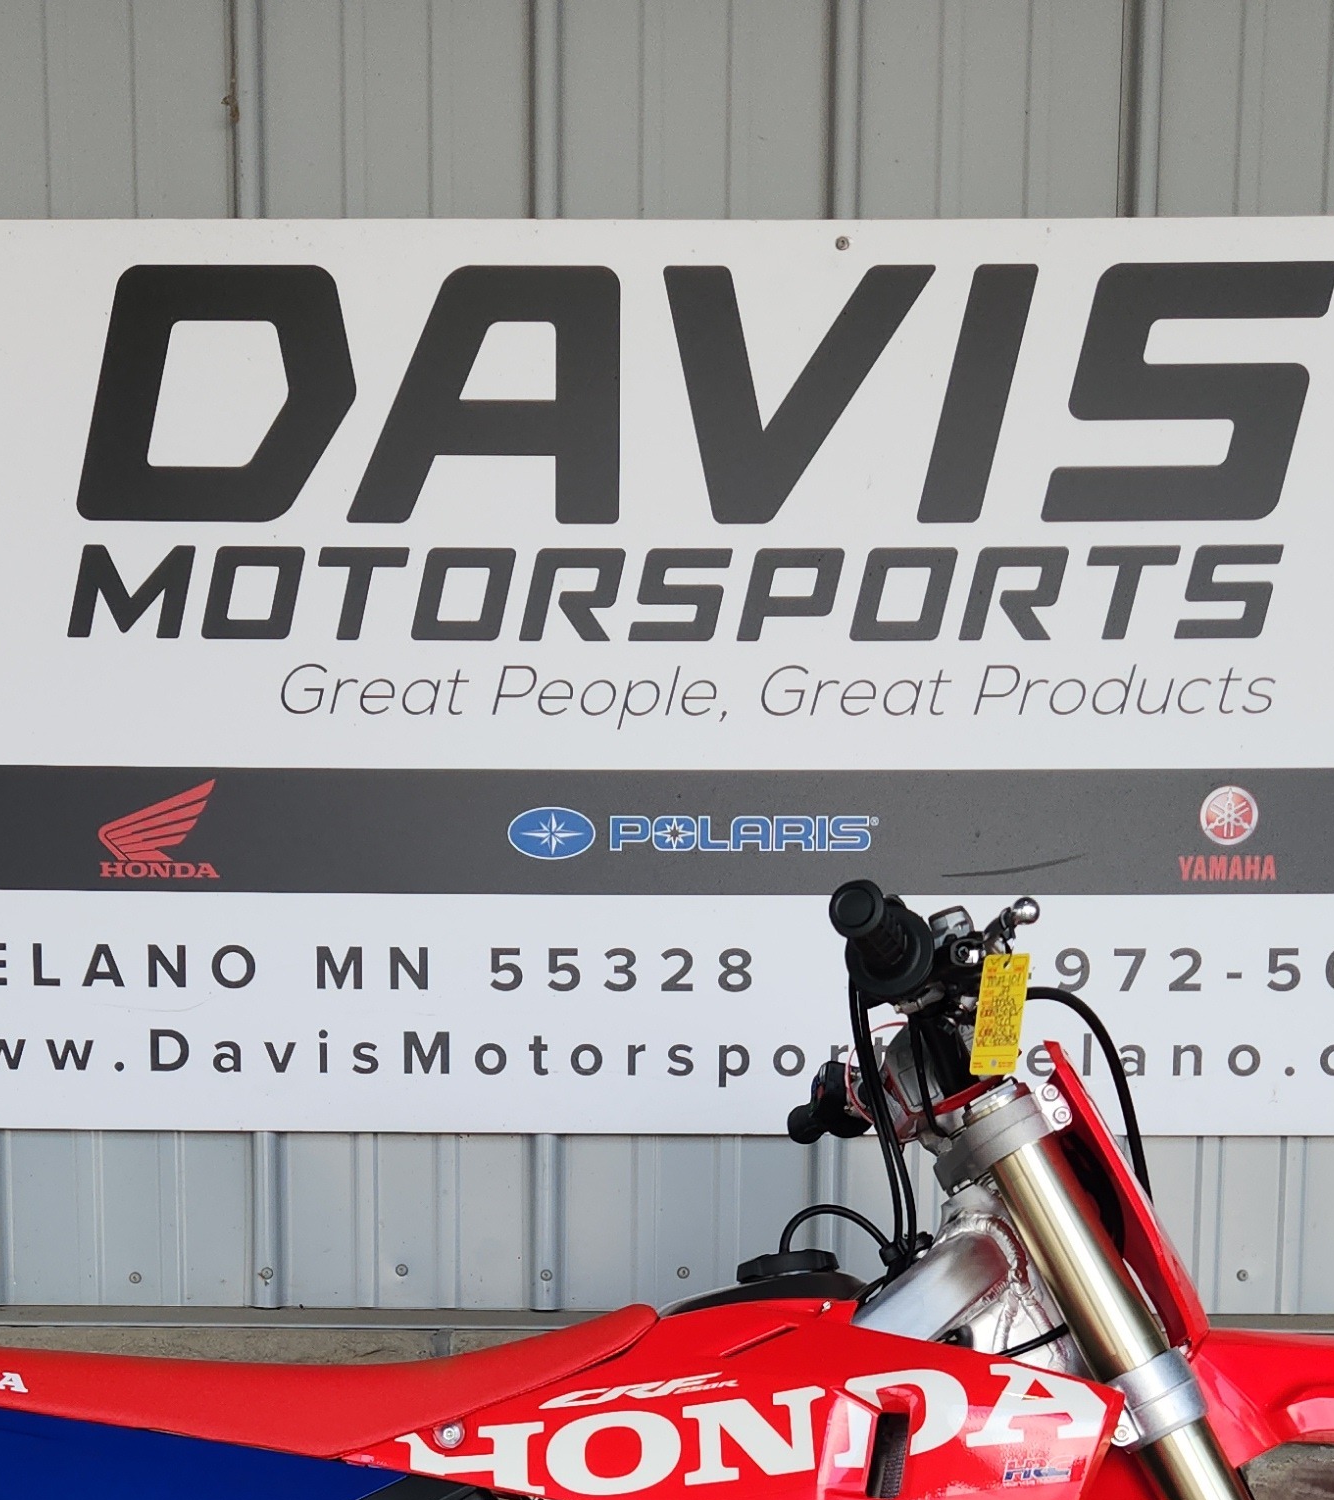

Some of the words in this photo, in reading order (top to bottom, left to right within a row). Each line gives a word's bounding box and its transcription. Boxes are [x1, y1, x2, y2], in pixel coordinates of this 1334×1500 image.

[67, 544, 1284, 641] MOTORSPORTS
[280, 663, 470, 716] Great
[491, 665, 728, 730] People,
[760, 664, 952, 717] Great
[973, 663, 1275, 717] Products
[100, 861, 220, 878] HONDA
[1179, 855, 1276, 881] YAMAHA
[316, 945, 429, 990] MN
[490, 947, 752, 992] 55328
[394, 1363, 1111, 1496] HONDA
